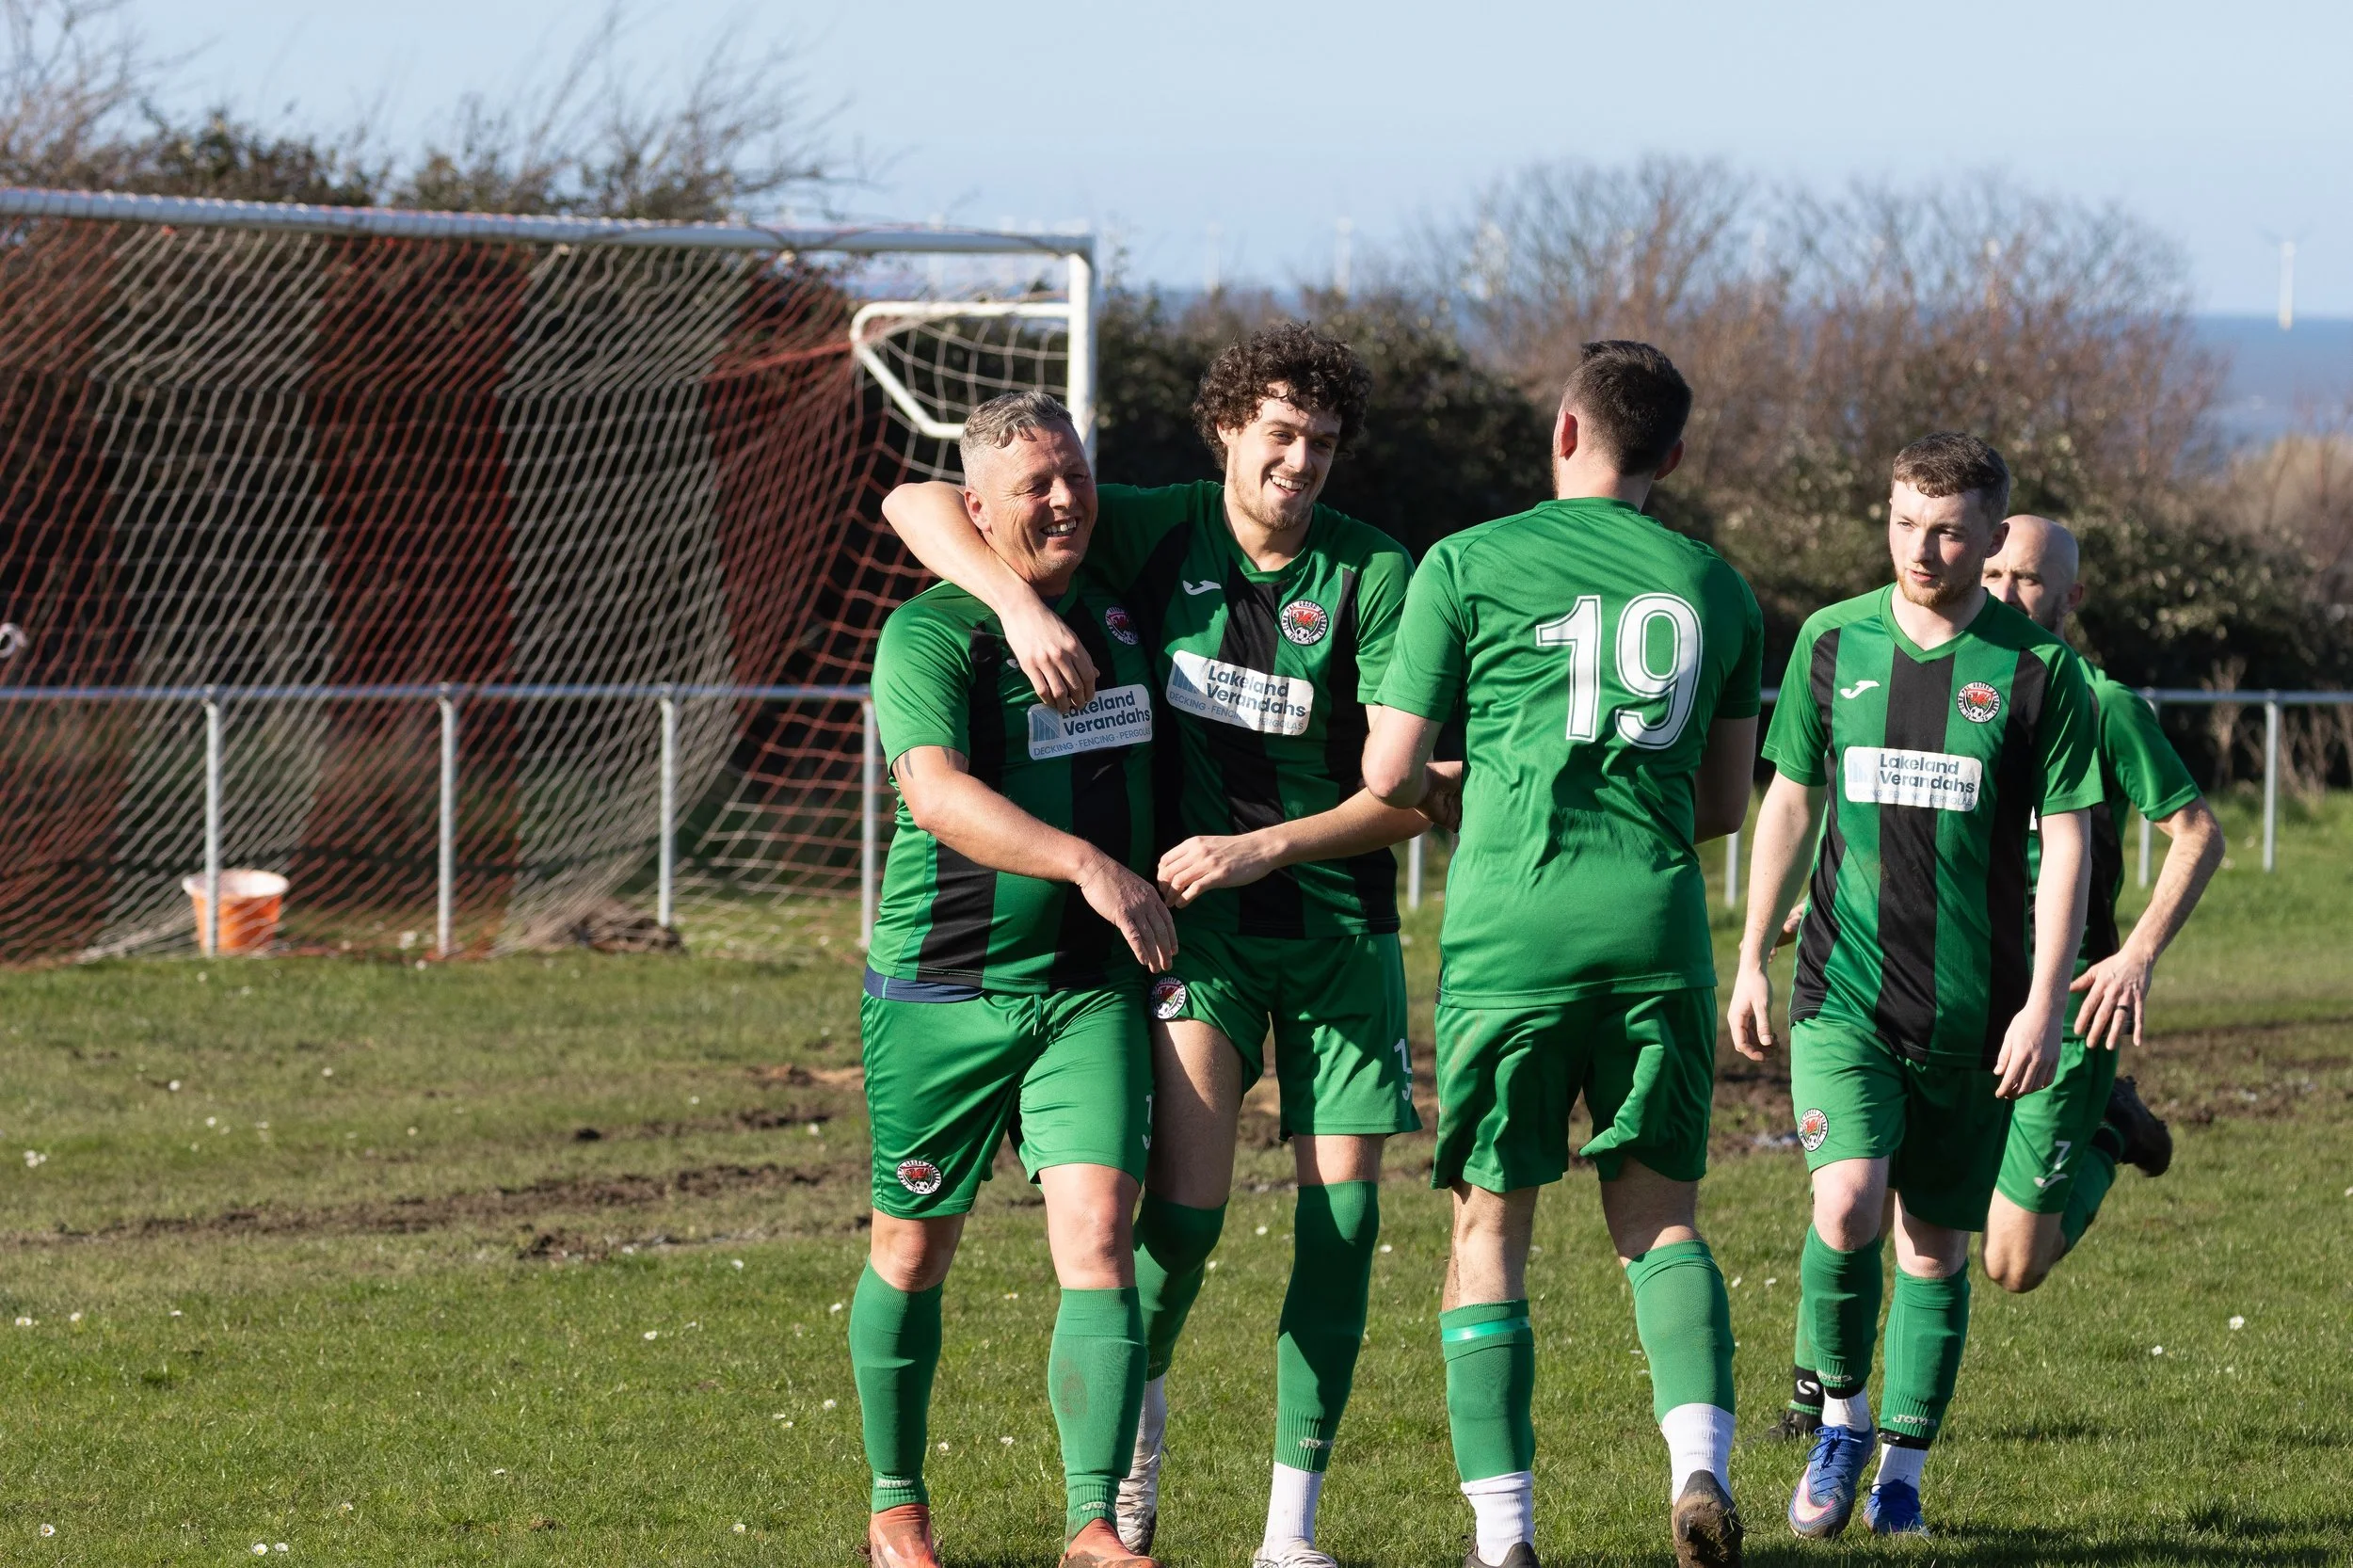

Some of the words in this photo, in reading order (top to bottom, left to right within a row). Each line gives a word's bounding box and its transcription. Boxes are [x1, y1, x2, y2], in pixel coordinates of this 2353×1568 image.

[1209, 664, 1289, 697] Lakeland
[1536, 593, 1703, 749] 19
[1169, 691, 1206, 711] DECKING
[1211, 706, 1249, 722] FENCING
[1207, 682, 1306, 717] Verandahs
[1063, 708, 1150, 736] Verandahs
[1033, 742, 1073, 757] DECKING
[1079, 733, 1115, 748] FENCING
[1881, 753, 1960, 775] Lakeland
[1880, 770, 1975, 793] Verandahs
[2055, 1140, 2071, 1170] 7
